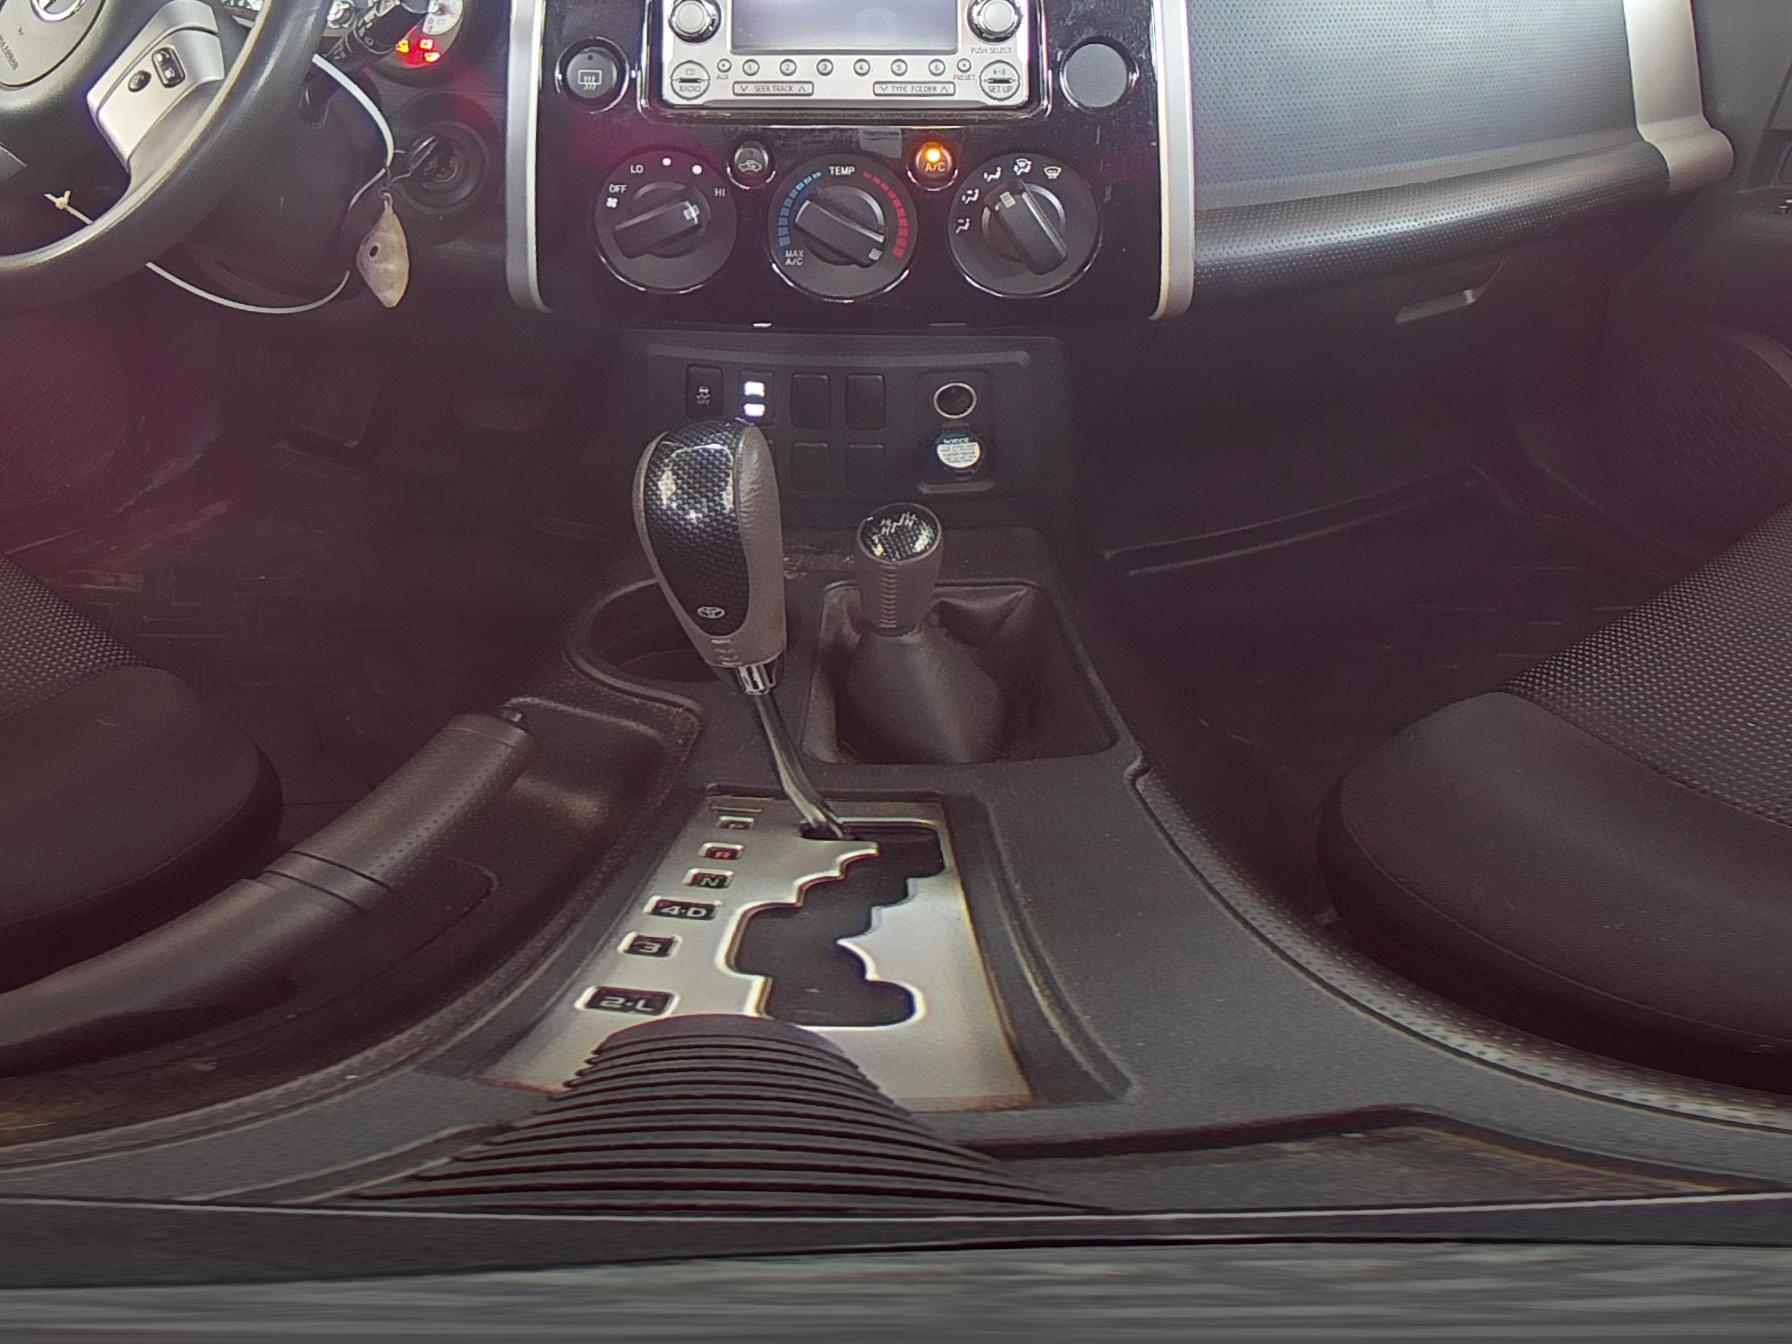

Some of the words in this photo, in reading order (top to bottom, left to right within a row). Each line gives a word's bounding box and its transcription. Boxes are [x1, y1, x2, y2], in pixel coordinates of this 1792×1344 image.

[630, 164, 644, 174] LO
[828, 166, 856, 176] TEMP
[925, 162, 946, 172] A/C
[609, 184, 627, 193] OFF
[714, 188, 726, 197] HI
[785, 249, 804, 258] MAX
[785, 258, 803, 266] A/C
[715, 851, 731, 859] R
[700, 877, 719, 887] N
[637, 942, 662, 954] 3
